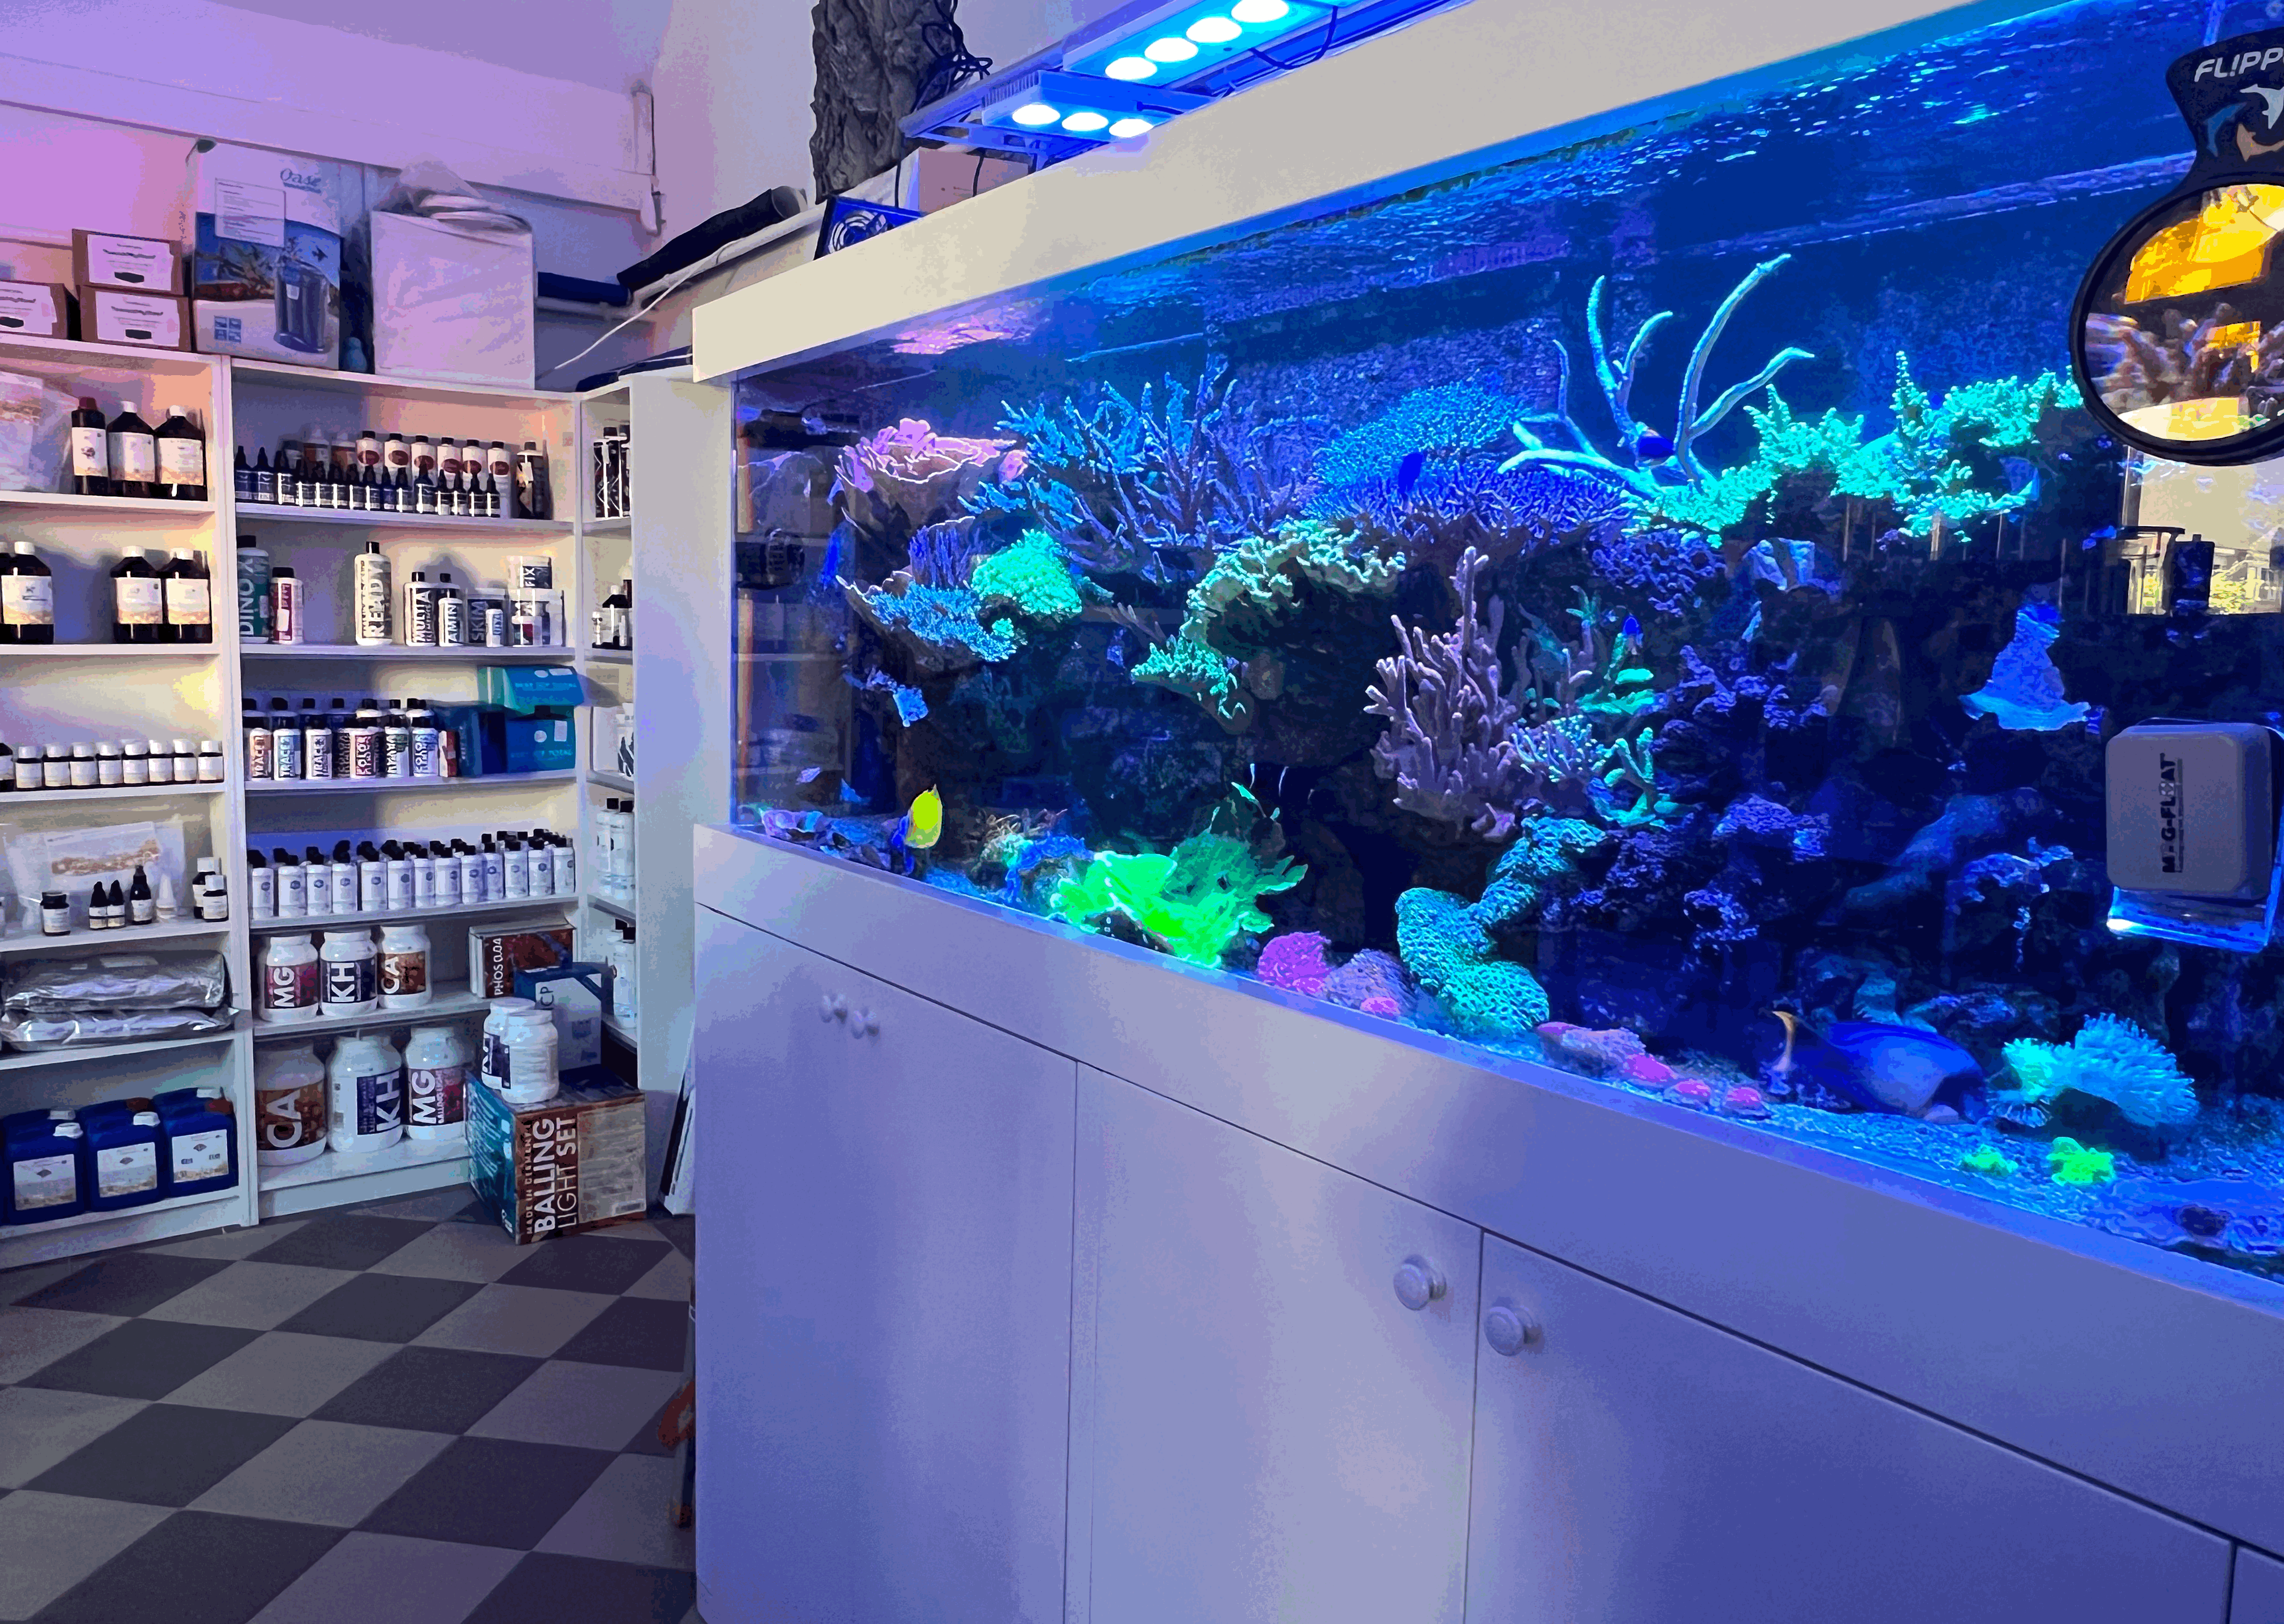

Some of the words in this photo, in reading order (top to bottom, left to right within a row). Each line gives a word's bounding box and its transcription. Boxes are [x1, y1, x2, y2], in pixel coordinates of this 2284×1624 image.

[280, 168, 322, 189] Oase
[239, 579, 254, 636] DINO
[273, 966, 295, 1007] MG
[331, 962, 355, 1003] KH
[381, 956, 400, 994] CA
[493, 964, 504, 995] PHOS
[266, 1090, 302, 1148] CA
[376, 1071, 401, 1132] KH
[412, 1070, 437, 1124] MG
[556, 1117, 576, 1157] SET
[533, 1118, 556, 1233] BALLING
[556, 1164, 577, 1228] LIGHT
